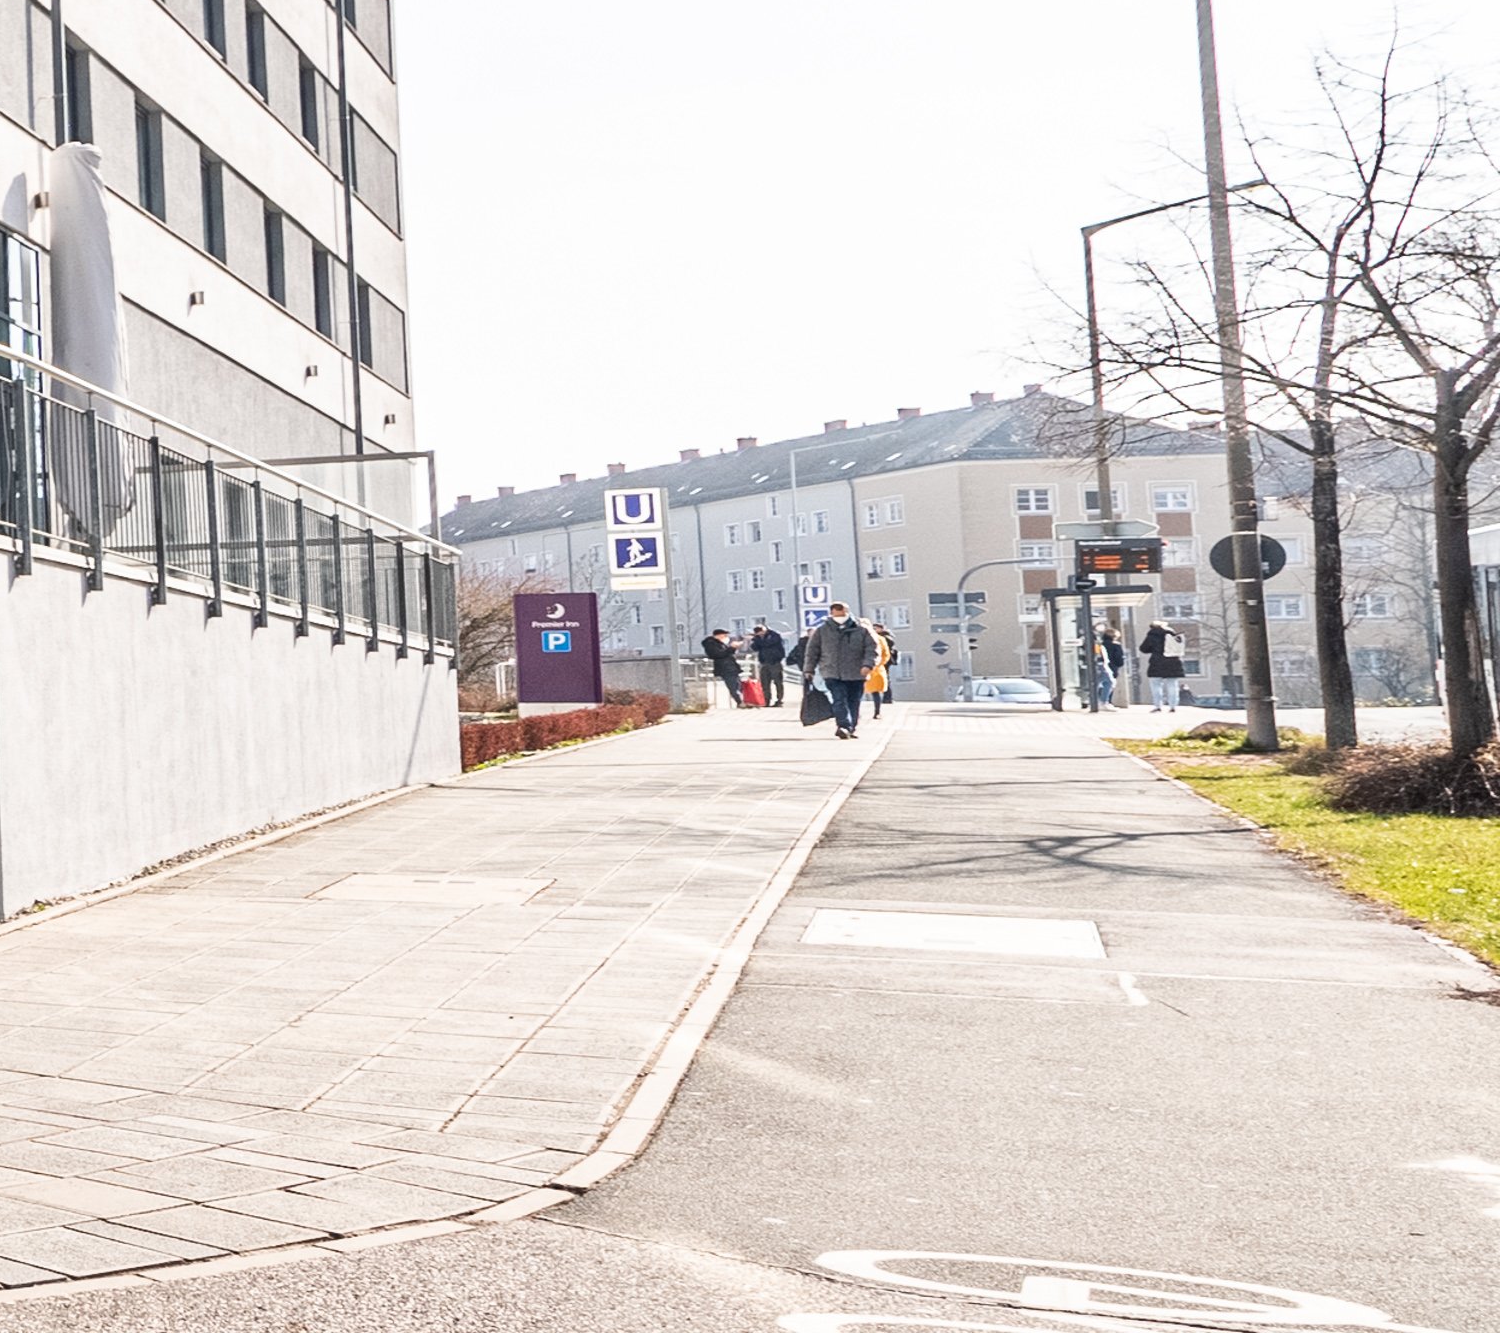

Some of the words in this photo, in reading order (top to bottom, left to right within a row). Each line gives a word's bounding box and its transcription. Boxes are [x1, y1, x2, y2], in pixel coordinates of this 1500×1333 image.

[615, 493, 651, 524] U
[805, 586, 825, 604] U
[531, 620, 565, 629] Premier
[548, 633, 566, 650] P
